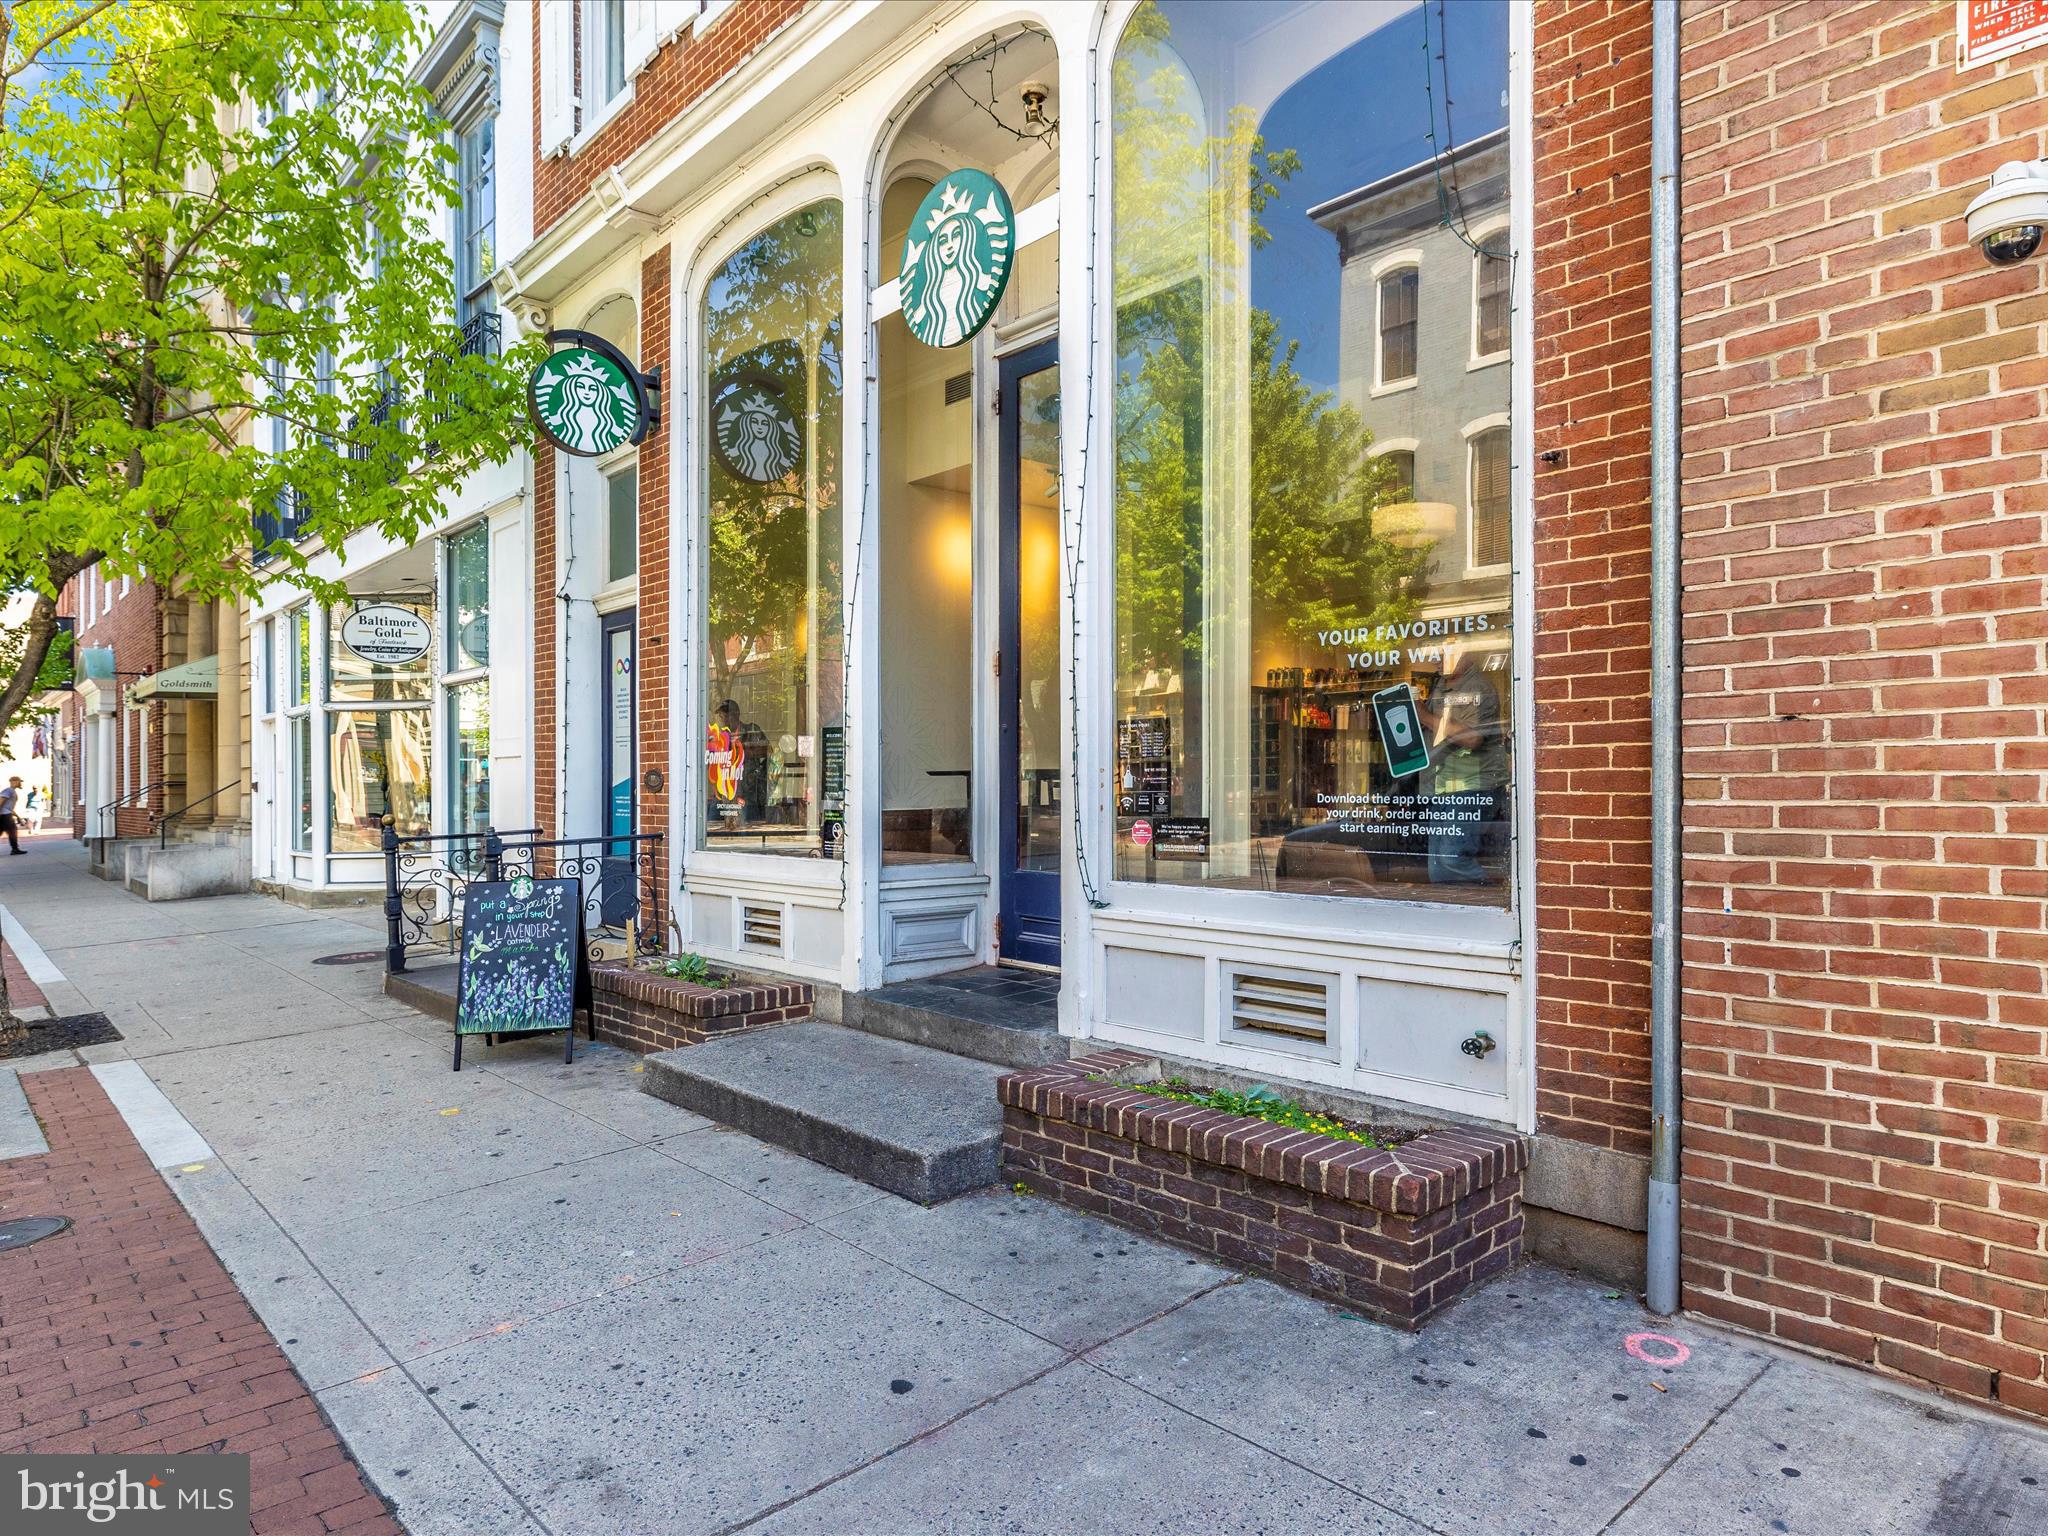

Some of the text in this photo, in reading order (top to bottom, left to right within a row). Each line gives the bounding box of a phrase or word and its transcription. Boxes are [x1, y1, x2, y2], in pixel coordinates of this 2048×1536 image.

[1974, 16, 2003, 30] WHEN
[2010, 5, 2036, 18] BELL
[2011, 12, 2036, 24] CALL
[1971, 34, 1993, 46] FIRE
[359, 615, 418, 628] Baltimore
[374, 628, 402, 638] Gold
[1318, 614, 1496, 647] YOUR FAVORITES.
[1347, 650, 1400, 669] YOUR
[160, 679, 213, 689] Goldsmith
[704, 749, 733, 768] Coming
[722, 765, 730, 781] in
[1316, 792, 1494, 807] Download the app to customize
[1326, 807, 1481, 821] your drink, order ahead and
[1339, 823, 1466, 837] start earning Rewards.
[480, 895, 561, 919] put a Spring
[495, 911, 546, 923] in your step
[495, 922, 551, 941] LAVENDER
